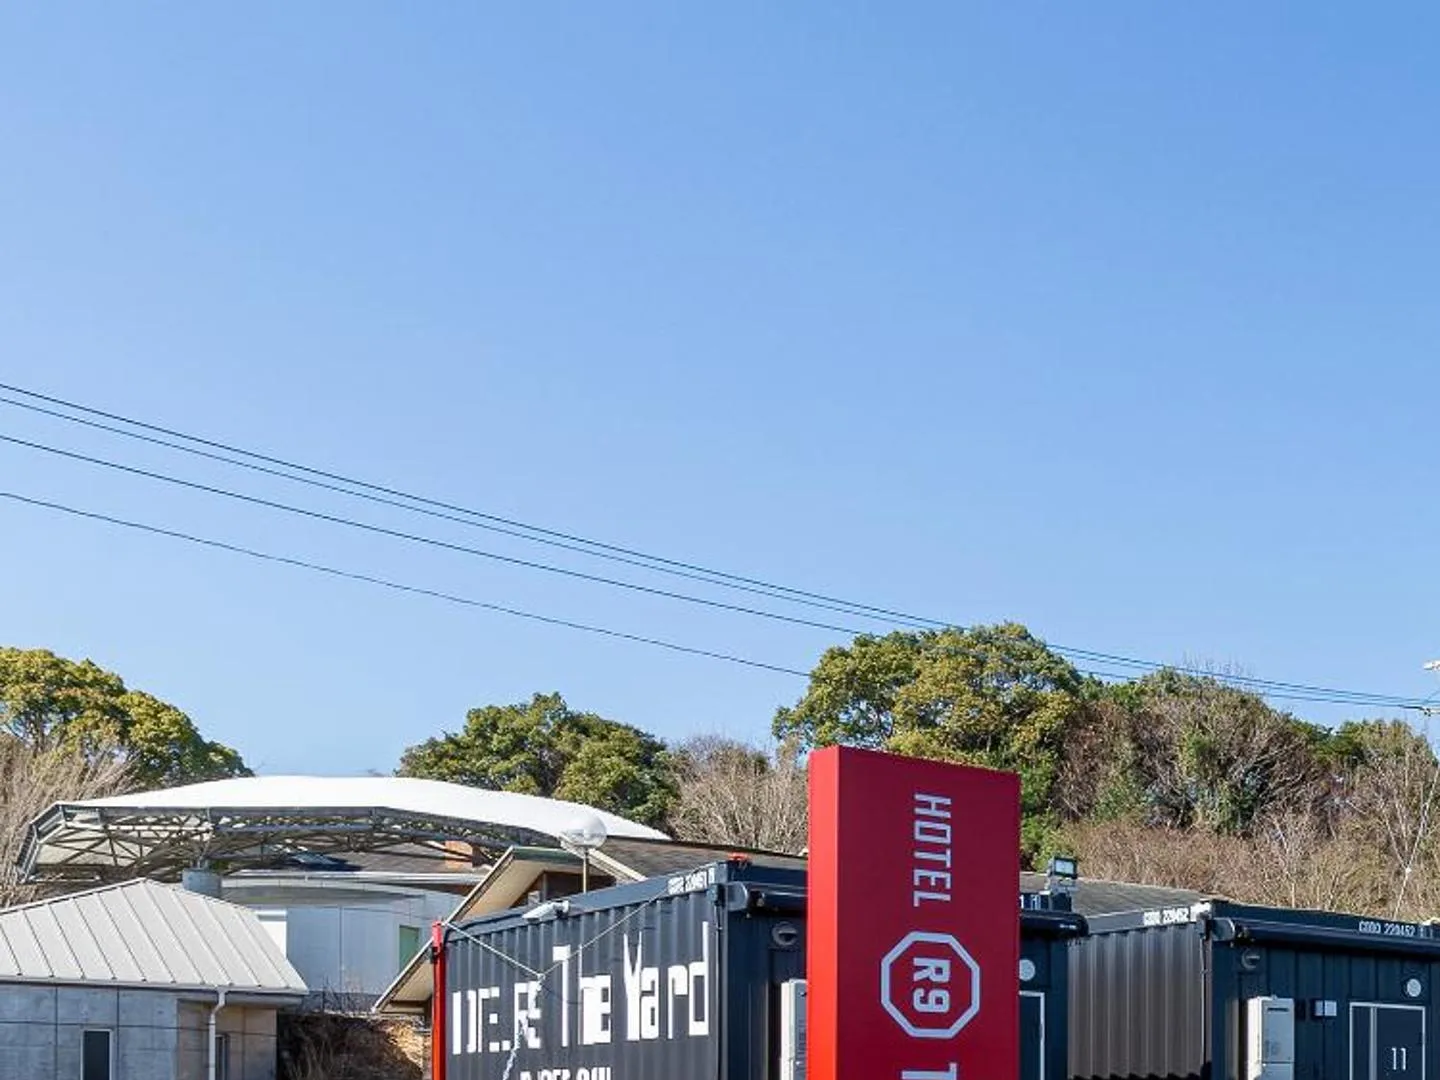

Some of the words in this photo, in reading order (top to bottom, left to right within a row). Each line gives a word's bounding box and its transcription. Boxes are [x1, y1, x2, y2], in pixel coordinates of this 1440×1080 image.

[913, 793, 952, 908] HOTEL
[623, 920, 709, 1042] Yard
[912, 956, 951, 1014] R9
[1391, 1047, 1407, 1070] 11
